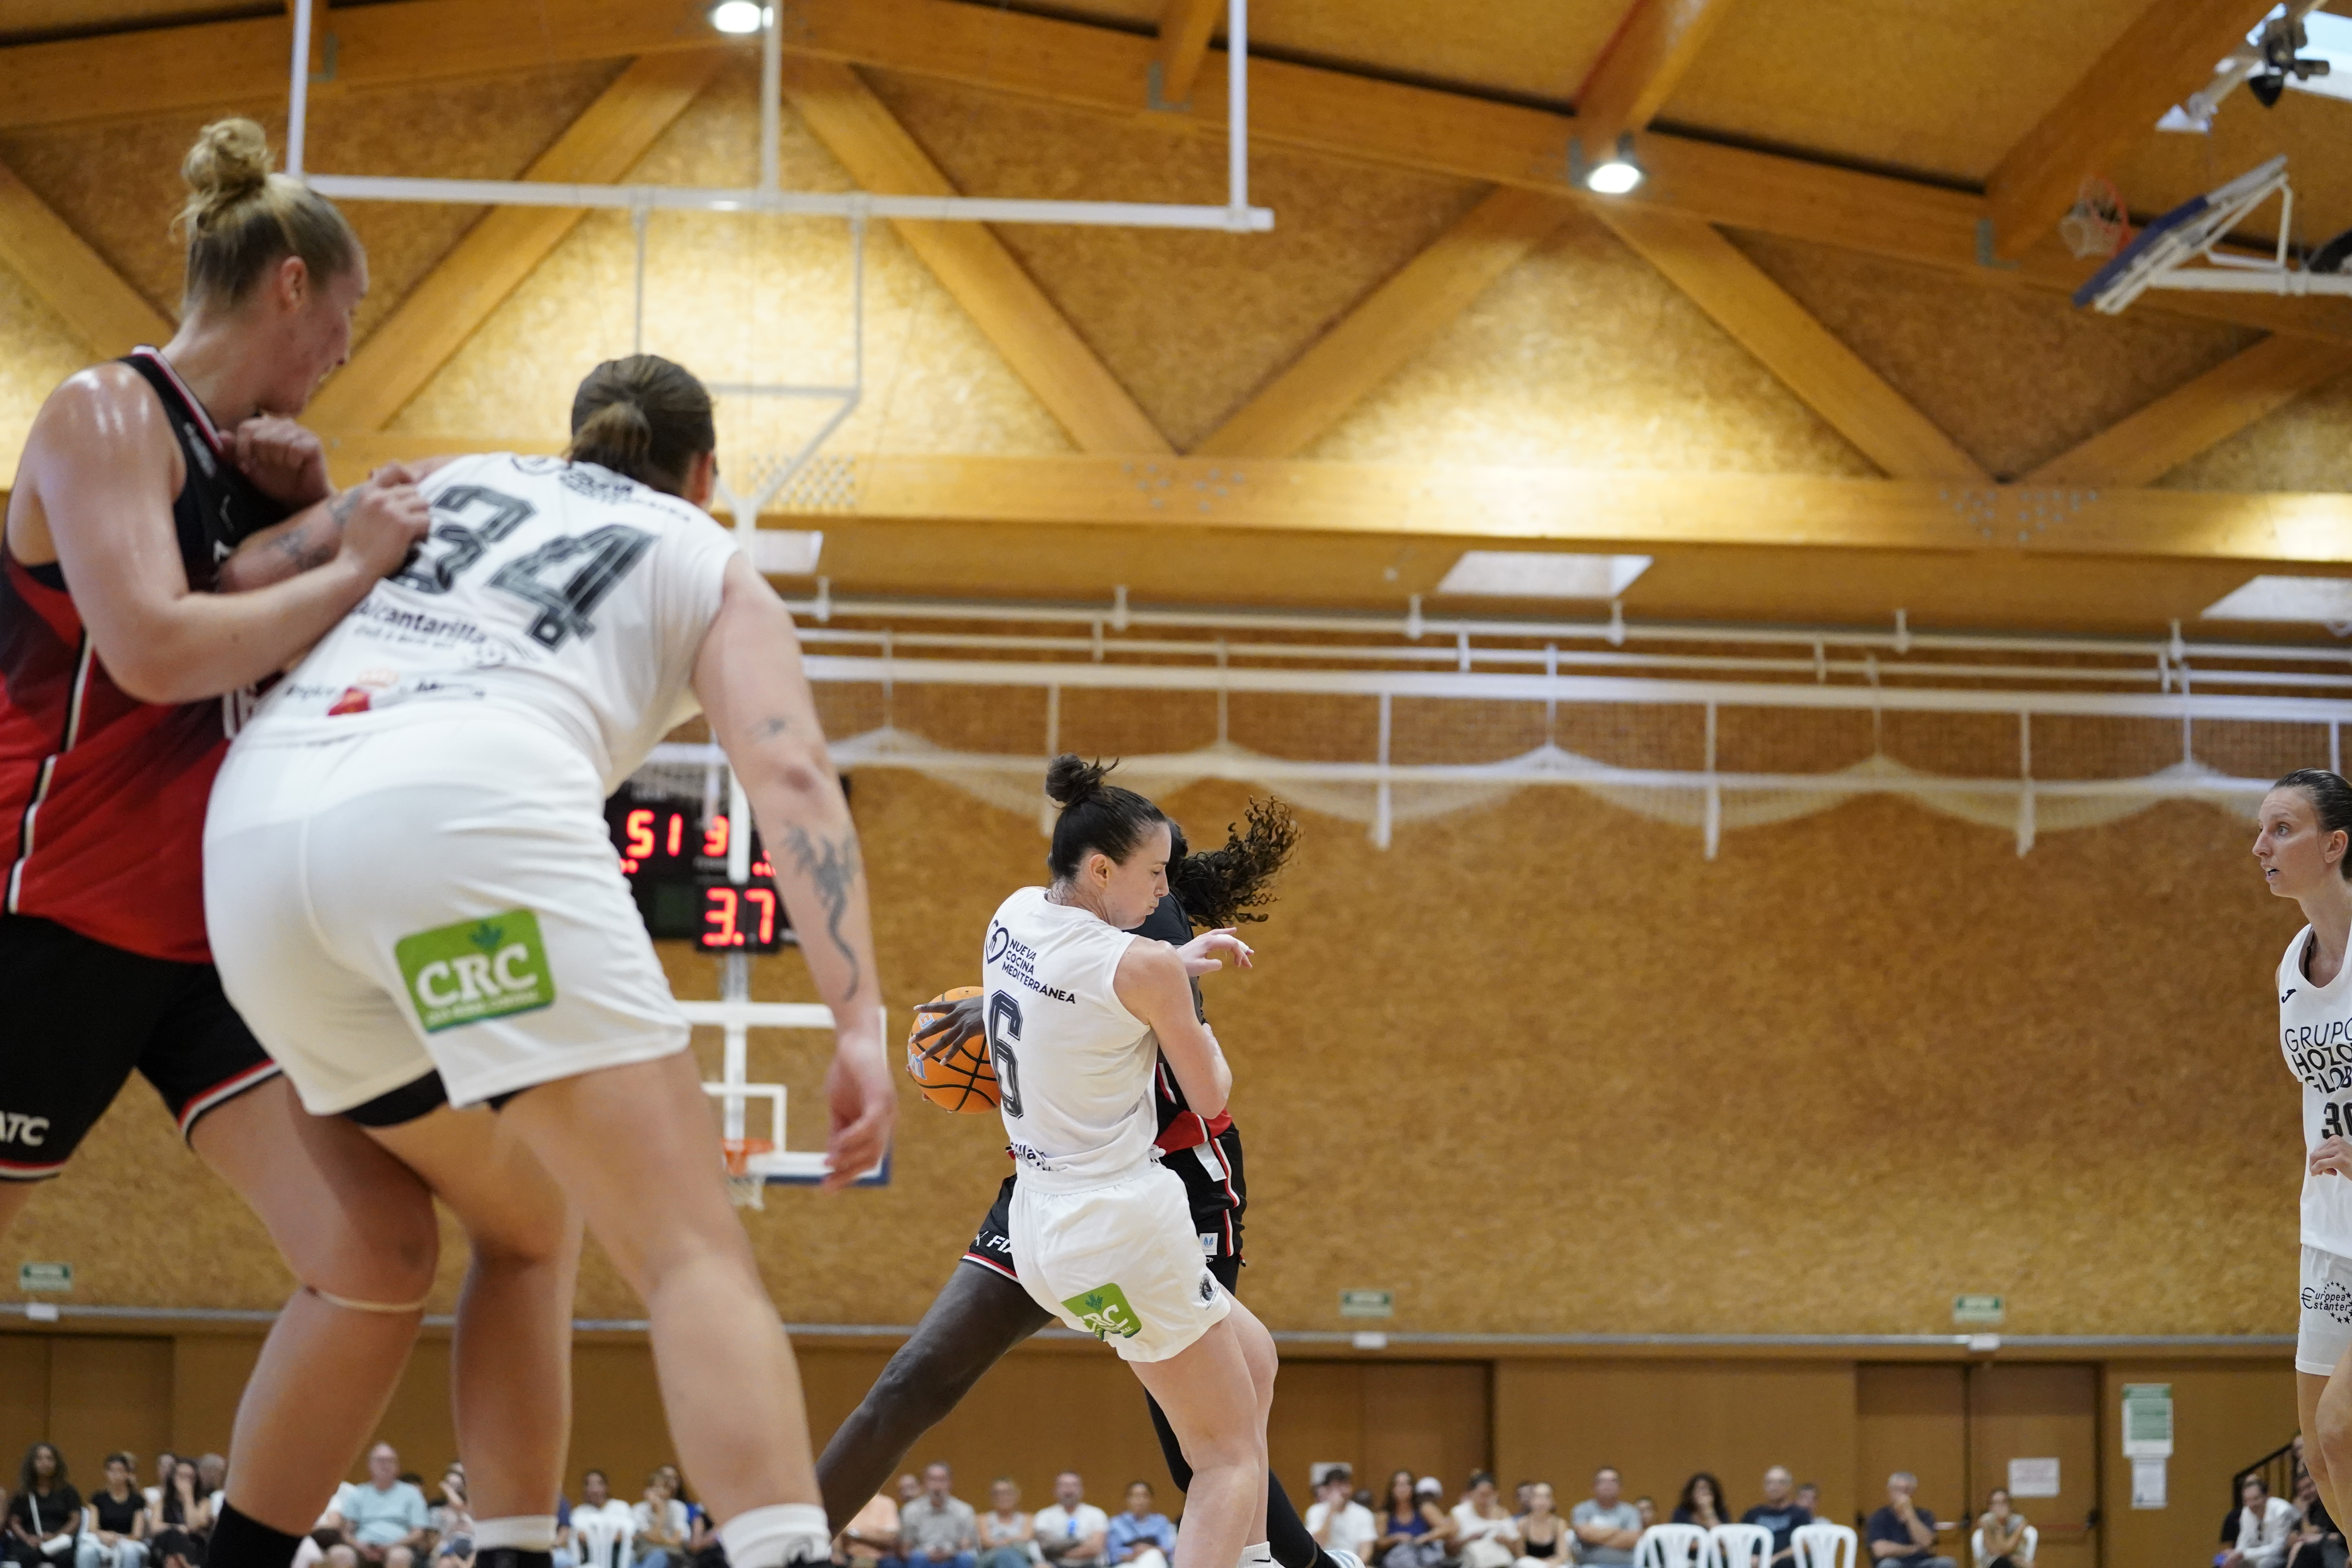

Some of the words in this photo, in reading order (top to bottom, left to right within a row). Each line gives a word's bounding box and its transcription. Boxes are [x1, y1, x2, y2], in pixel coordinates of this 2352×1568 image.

[387, 485, 661, 652] 34
[626, 809, 683, 858] 51
[1006, 951, 1034, 975] COCINA
[1009, 938, 1037, 962] NUEVA
[415, 942, 538, 1009] CRC
[1002, 961, 1076, 1004] MEDITERRÁNEA
[988, 989, 1024, 1120] 6
[2292, 1043, 2352, 1076] HOZO
